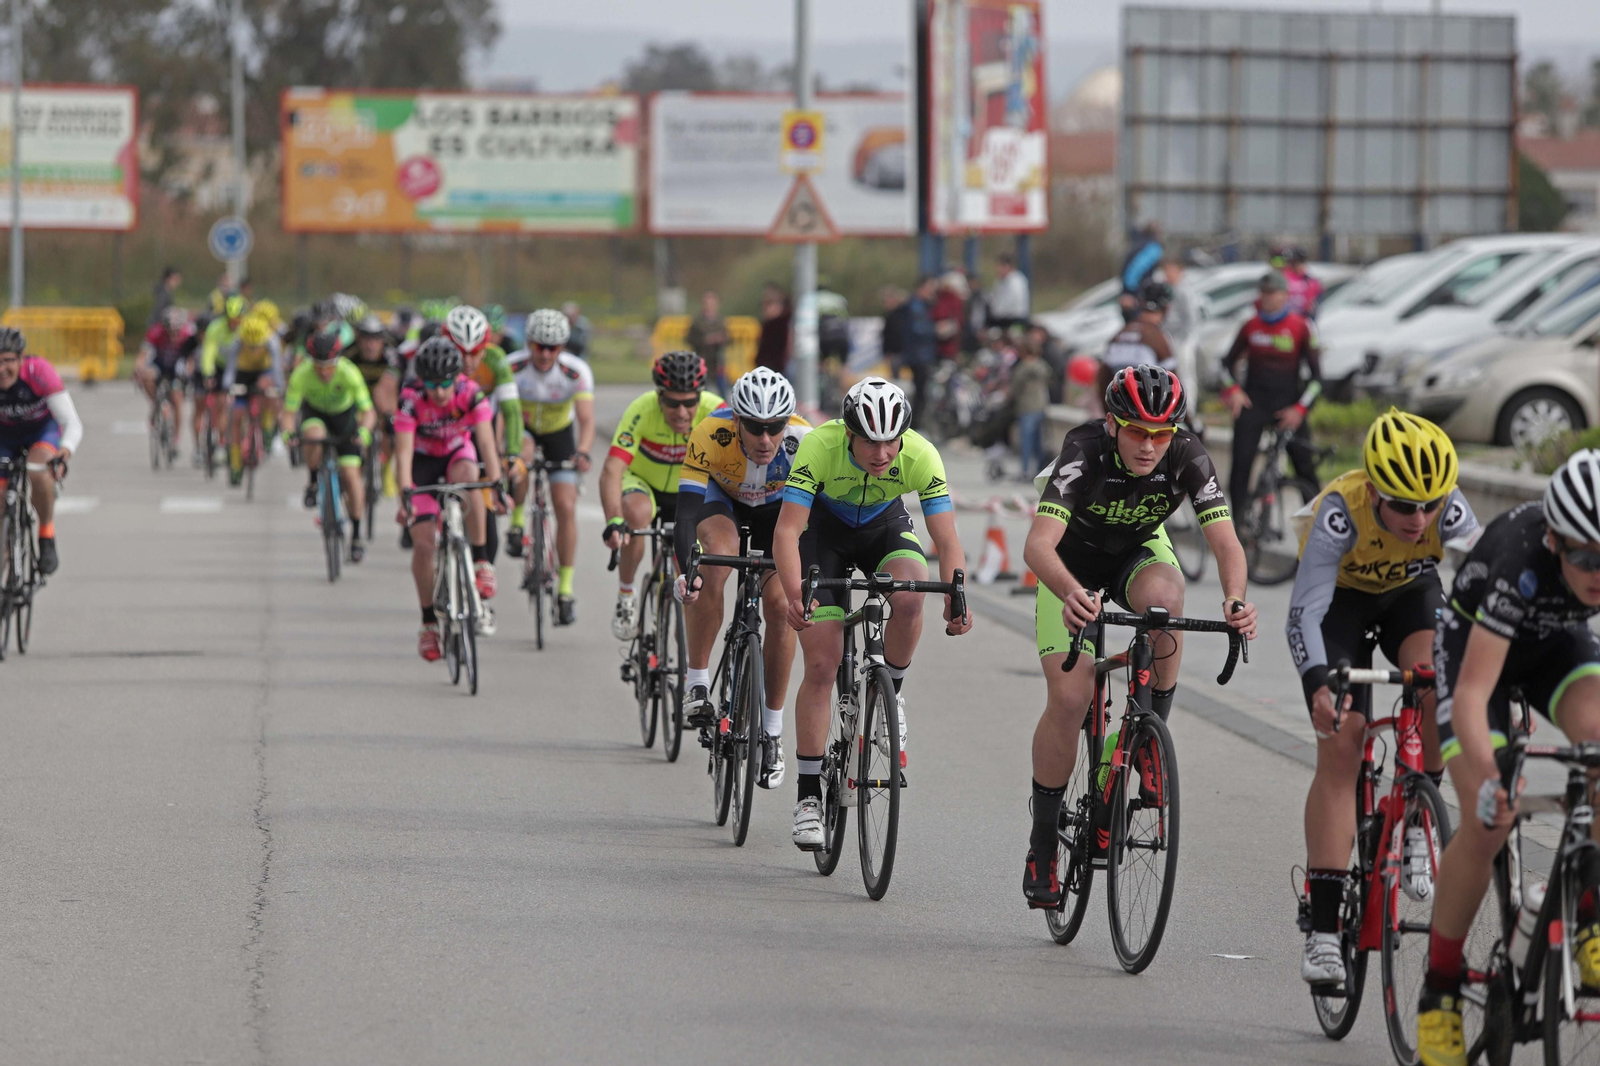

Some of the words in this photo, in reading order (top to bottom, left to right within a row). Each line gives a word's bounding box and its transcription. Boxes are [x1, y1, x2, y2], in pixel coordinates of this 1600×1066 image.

[485, 104, 619, 127] BARRIOS
[427, 133, 466, 157] ES
[476, 133, 618, 158] CULTURA
[1086, 499, 1150, 517] bike
[1289, 607, 1310, 667] BIKESS
